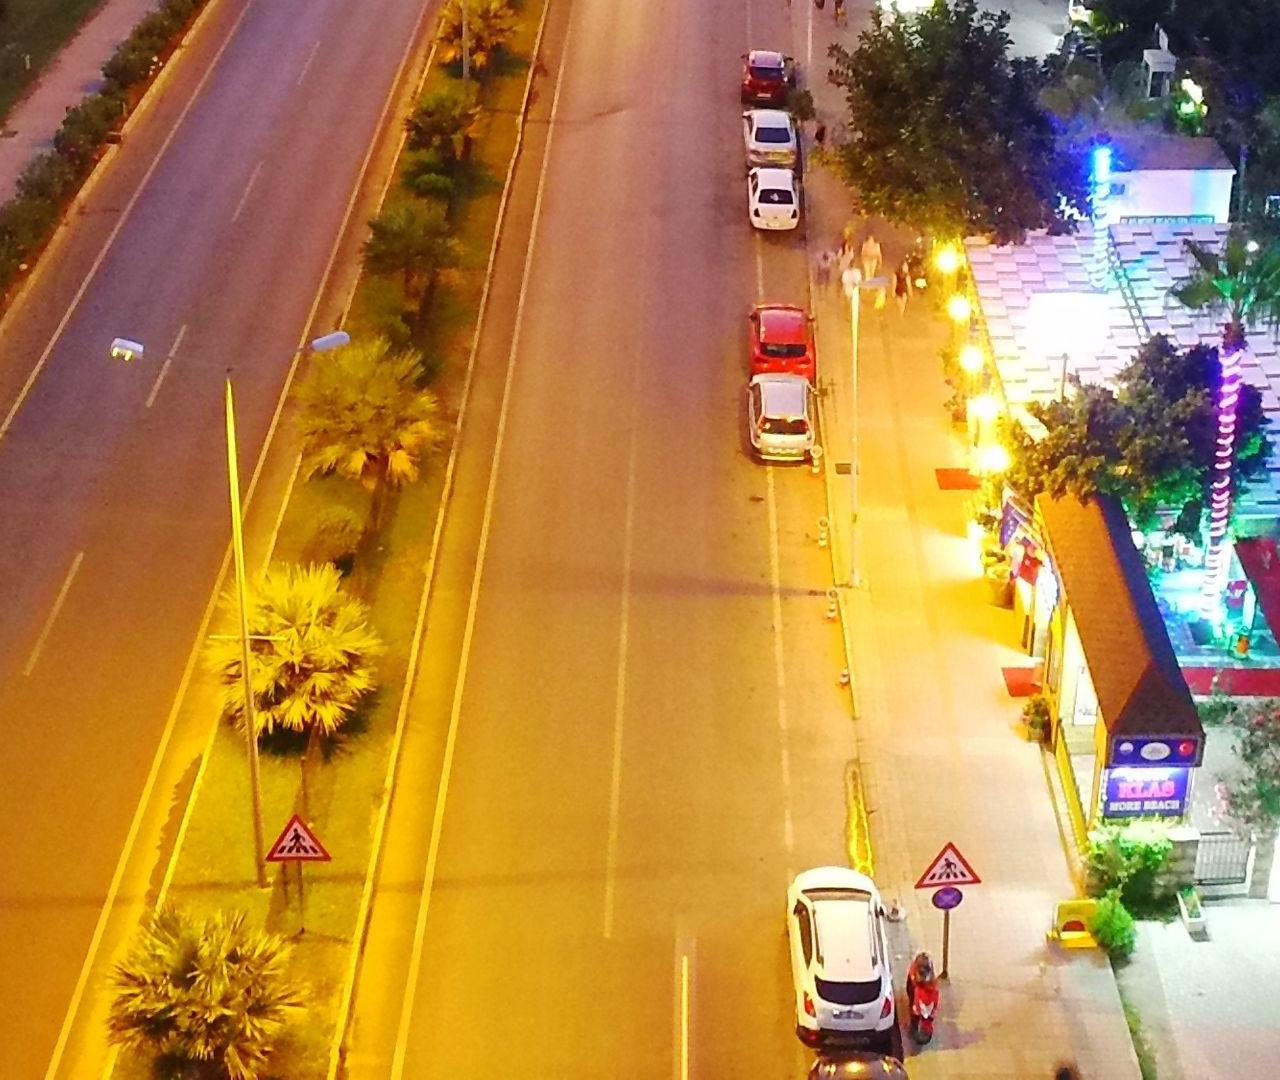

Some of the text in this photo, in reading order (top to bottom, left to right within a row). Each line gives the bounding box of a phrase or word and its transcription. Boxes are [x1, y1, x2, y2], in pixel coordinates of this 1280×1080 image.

[1118, 780, 1175, 798] KLAS
[1109, 799, 1180, 811] MORE BEACH
